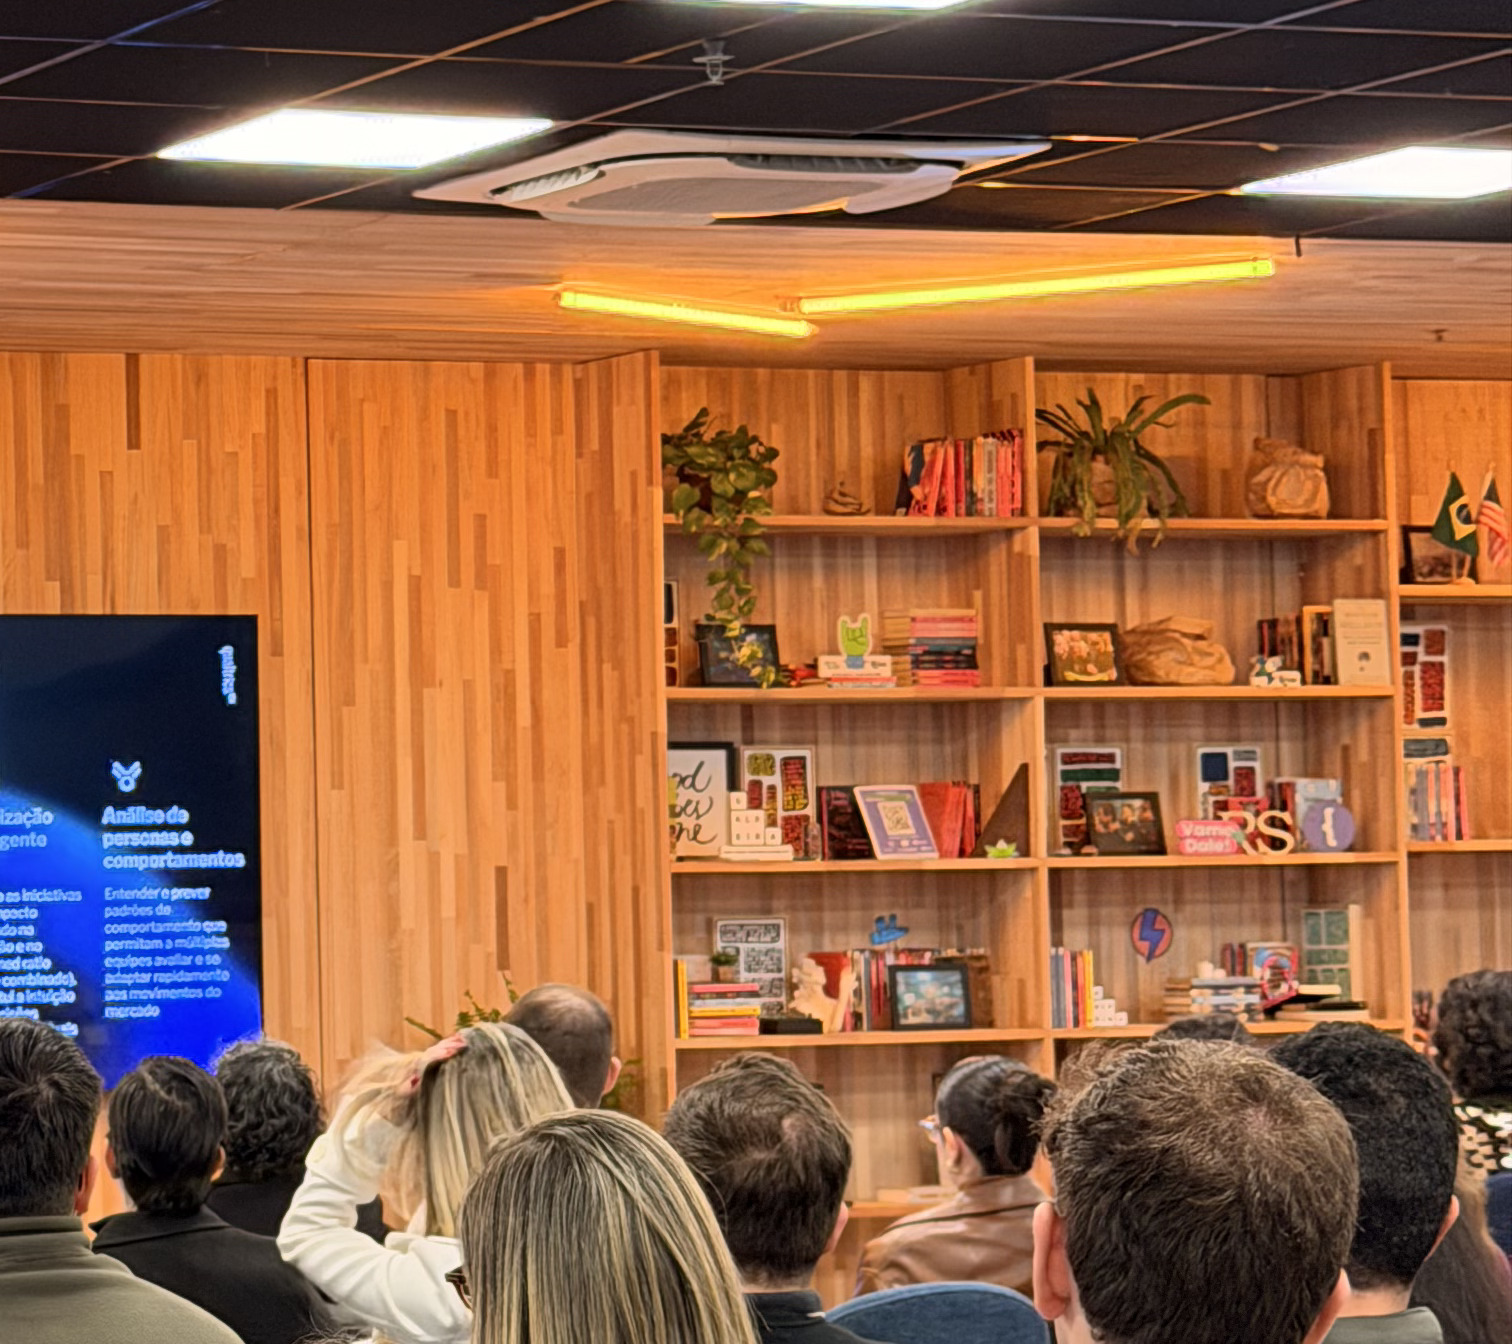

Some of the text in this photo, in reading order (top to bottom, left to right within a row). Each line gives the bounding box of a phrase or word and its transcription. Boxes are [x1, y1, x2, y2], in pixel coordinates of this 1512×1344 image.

[101, 805, 190, 825] Análise de
[102, 830, 194, 849] personas e
[102, 850, 246, 871] comportamentos
